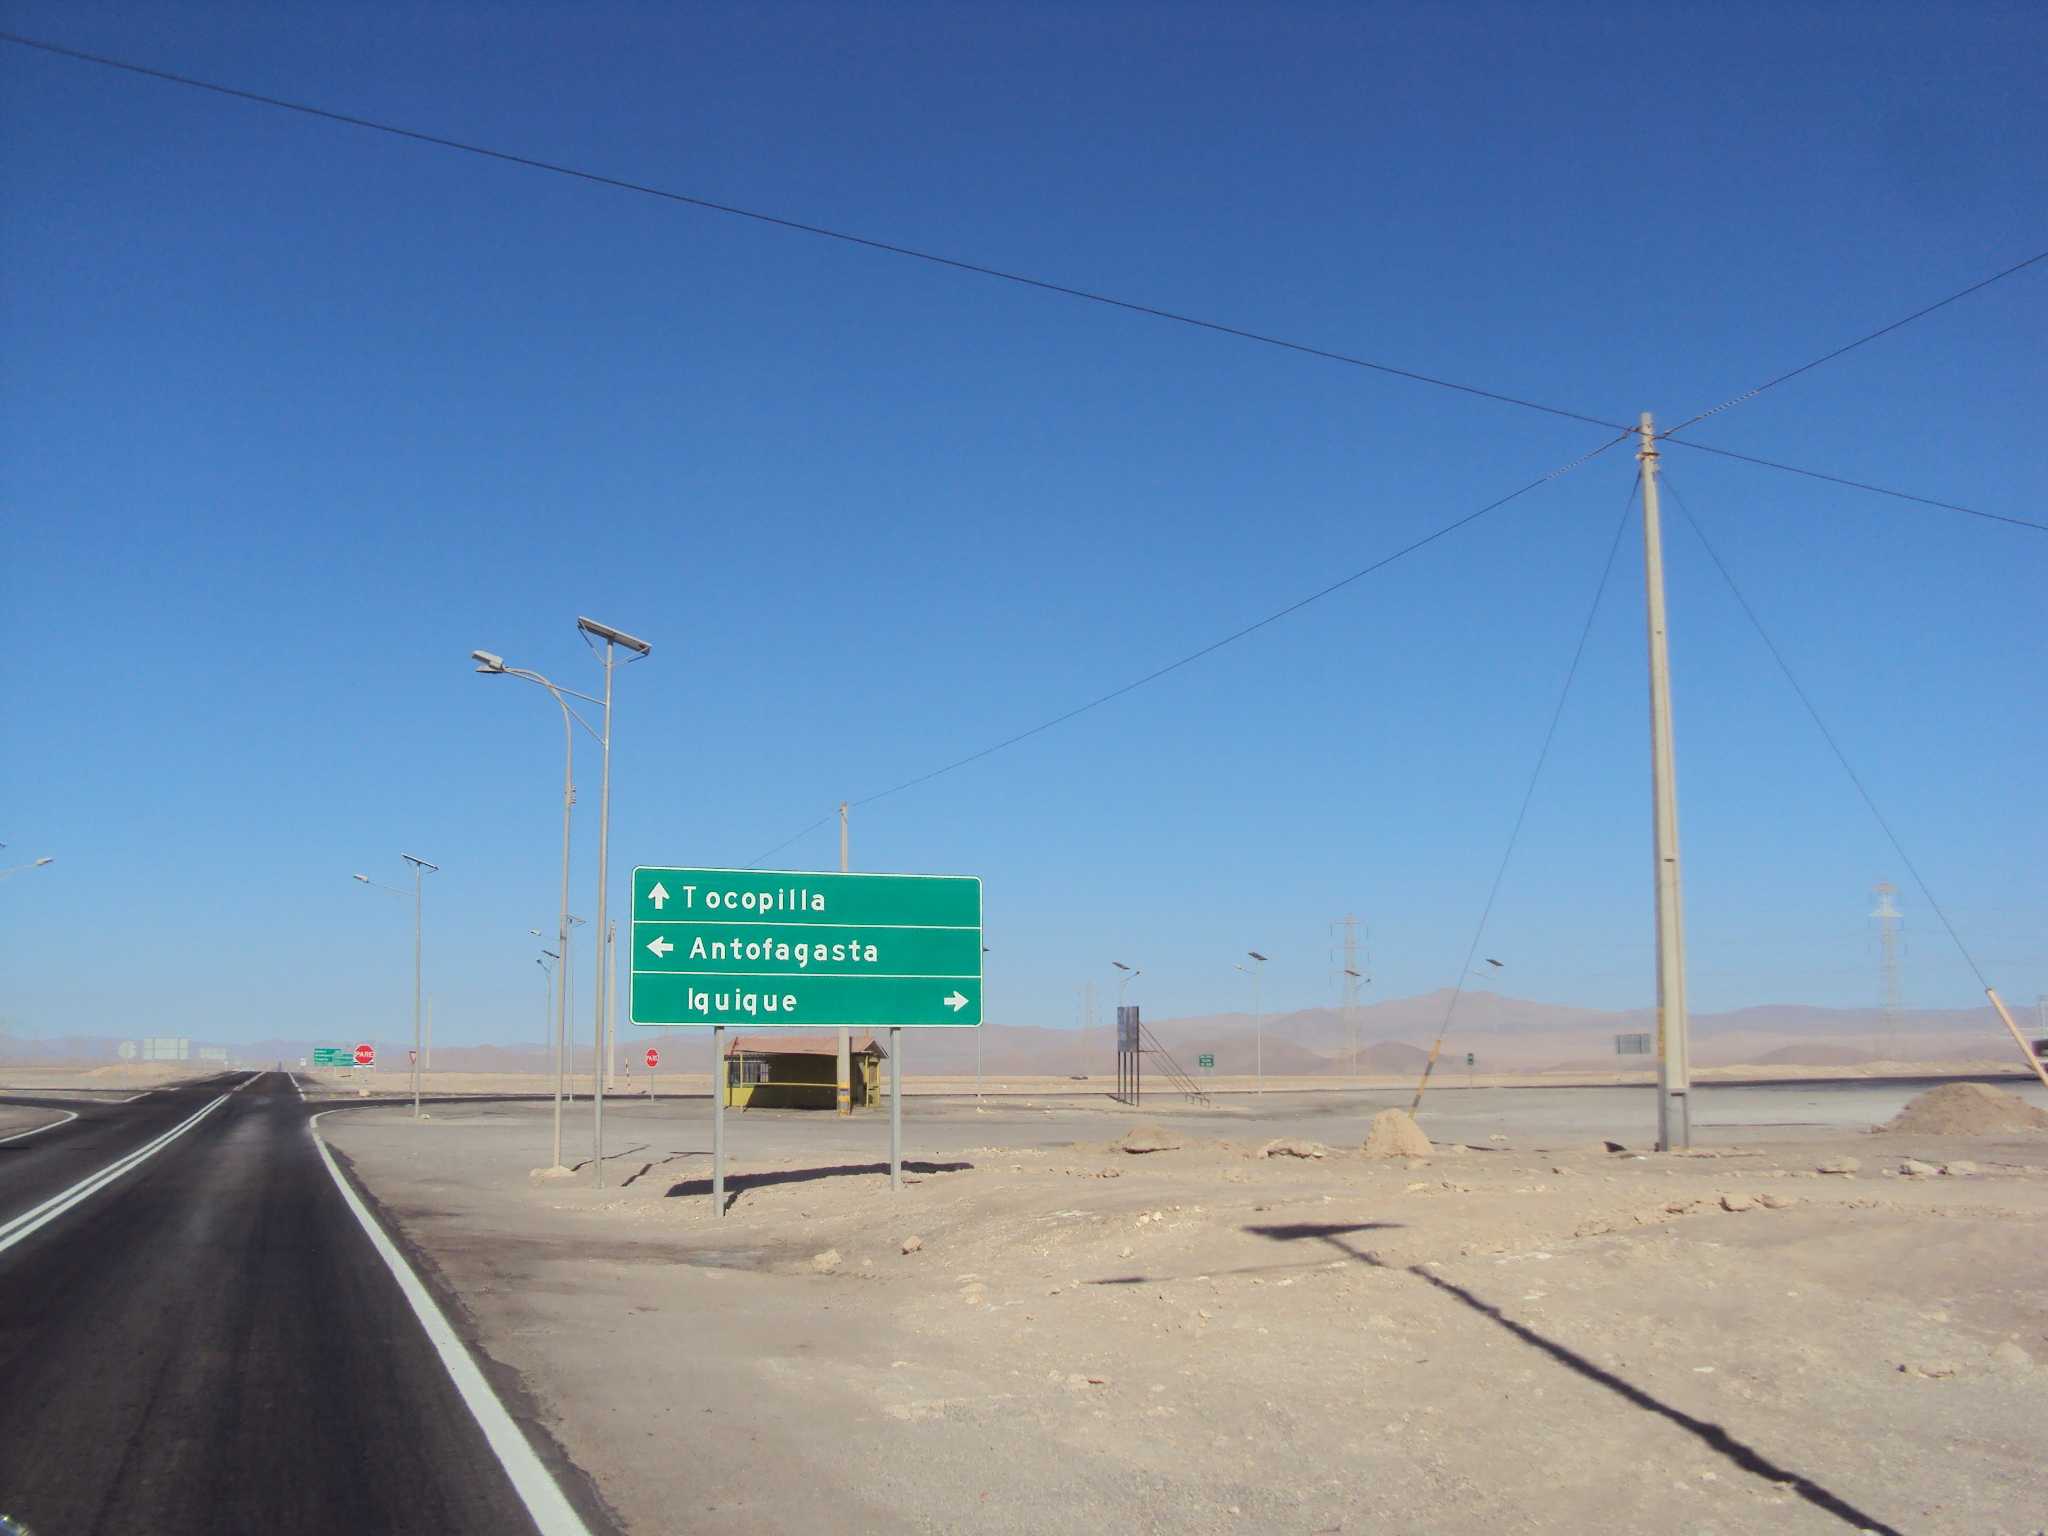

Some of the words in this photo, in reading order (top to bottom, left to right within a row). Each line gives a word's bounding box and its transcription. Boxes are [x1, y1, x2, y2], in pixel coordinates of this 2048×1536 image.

[683, 886, 825, 914] Tocopilla
[689, 937, 878, 967] Antofagasta
[688, 988, 796, 1016] Iquique
